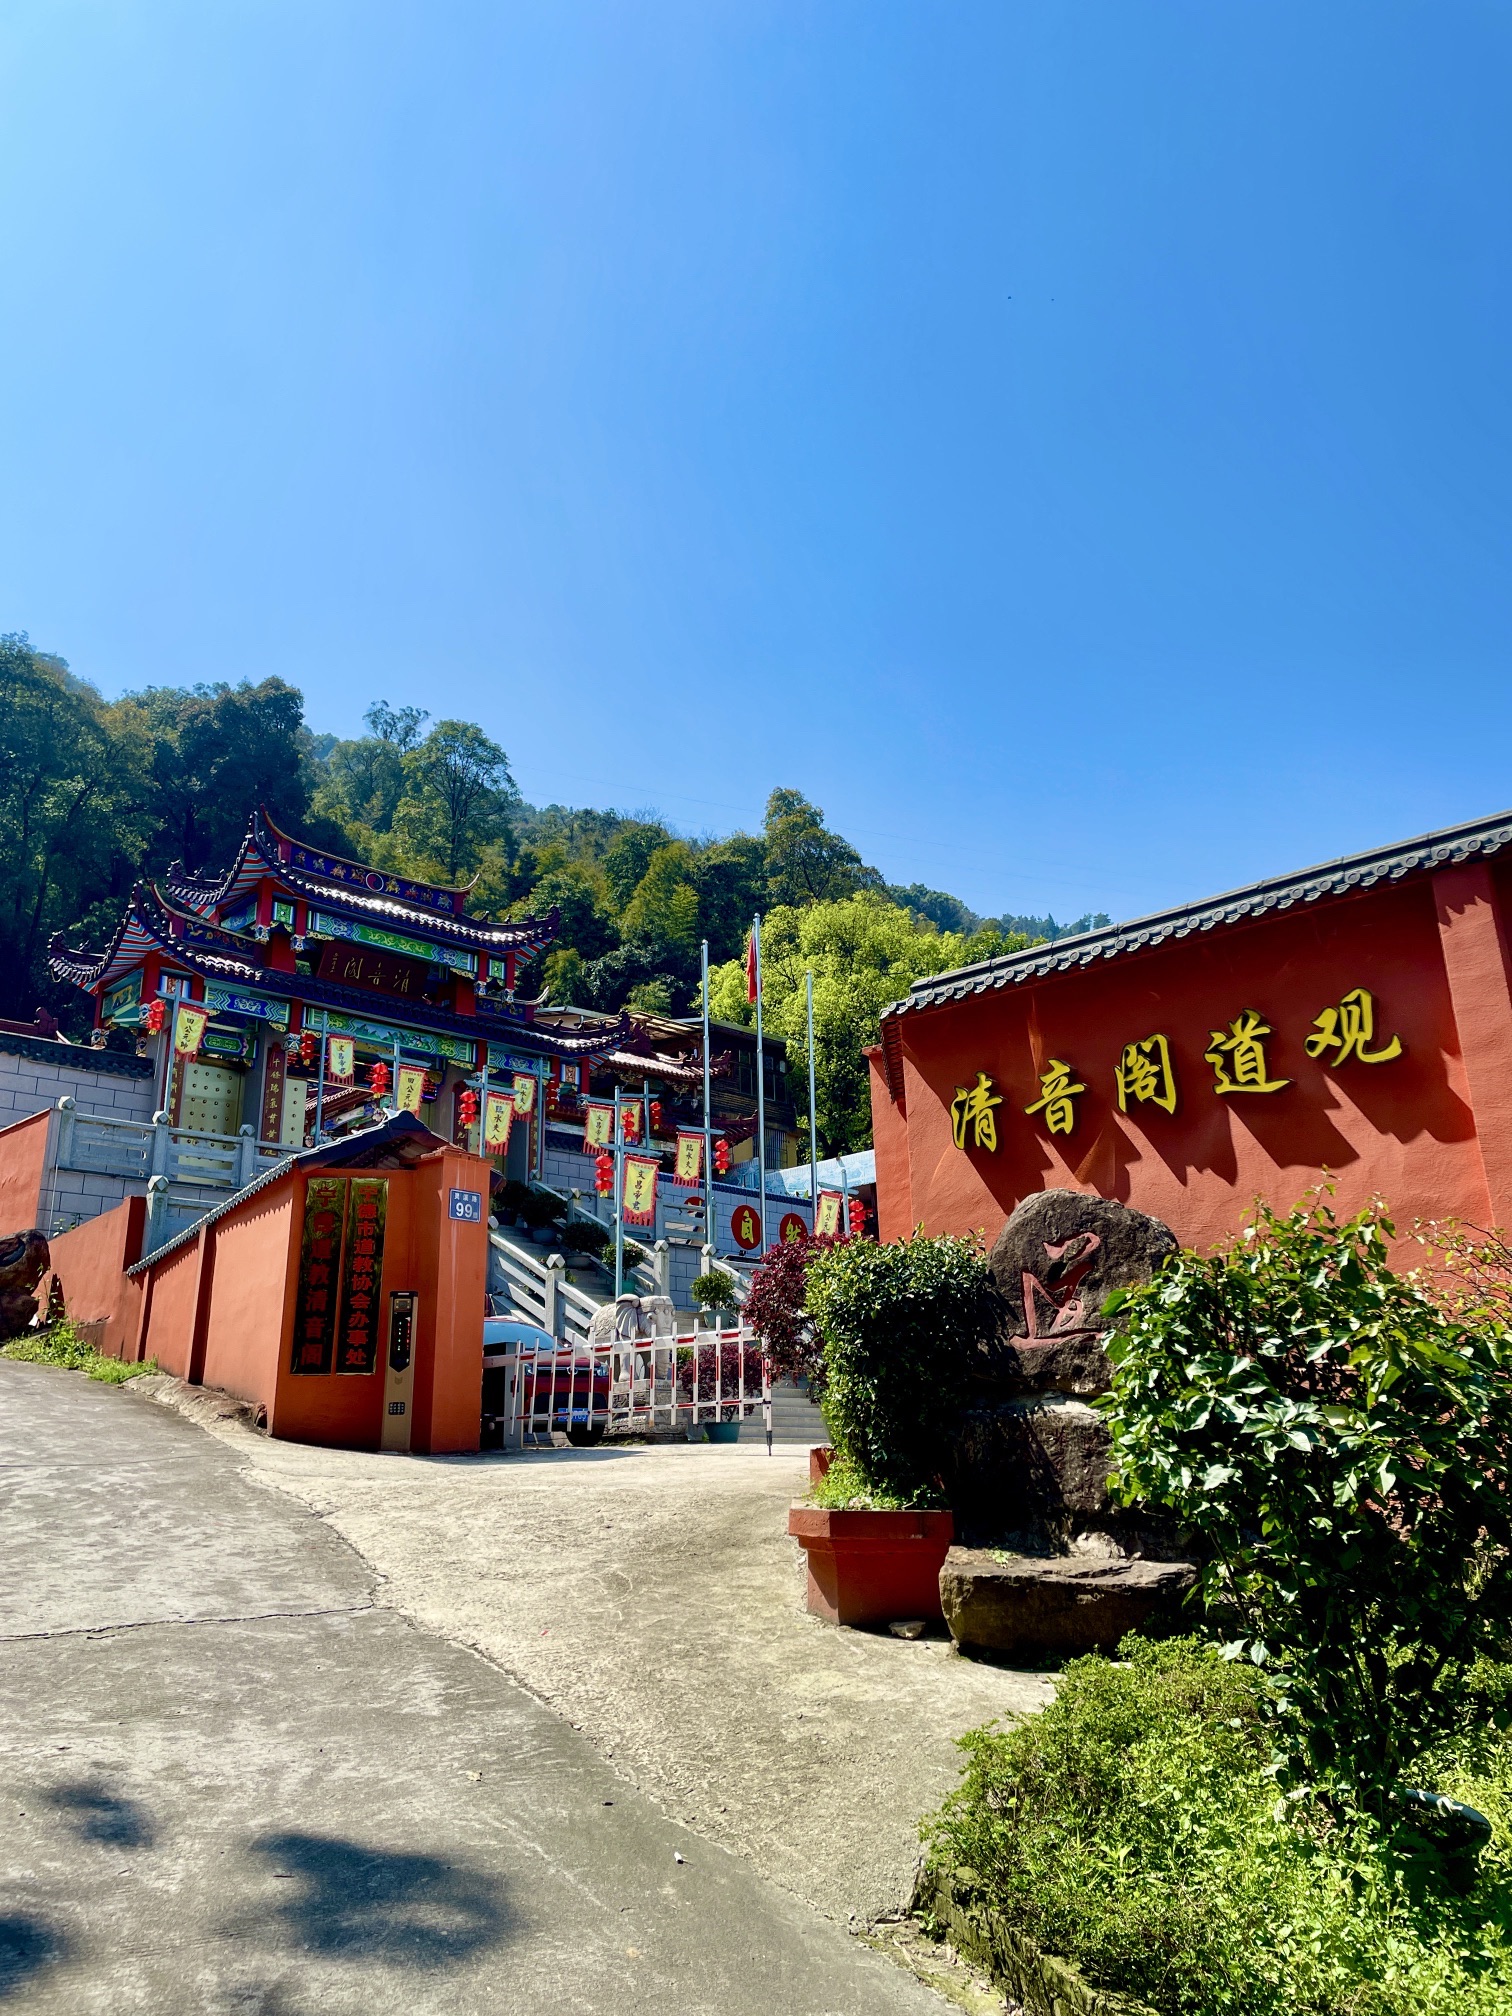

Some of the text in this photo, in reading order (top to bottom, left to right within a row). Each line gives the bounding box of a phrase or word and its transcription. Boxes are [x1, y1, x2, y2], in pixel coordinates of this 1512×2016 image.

[346, 1185, 378, 1365] 宁德市道教协会办事处
